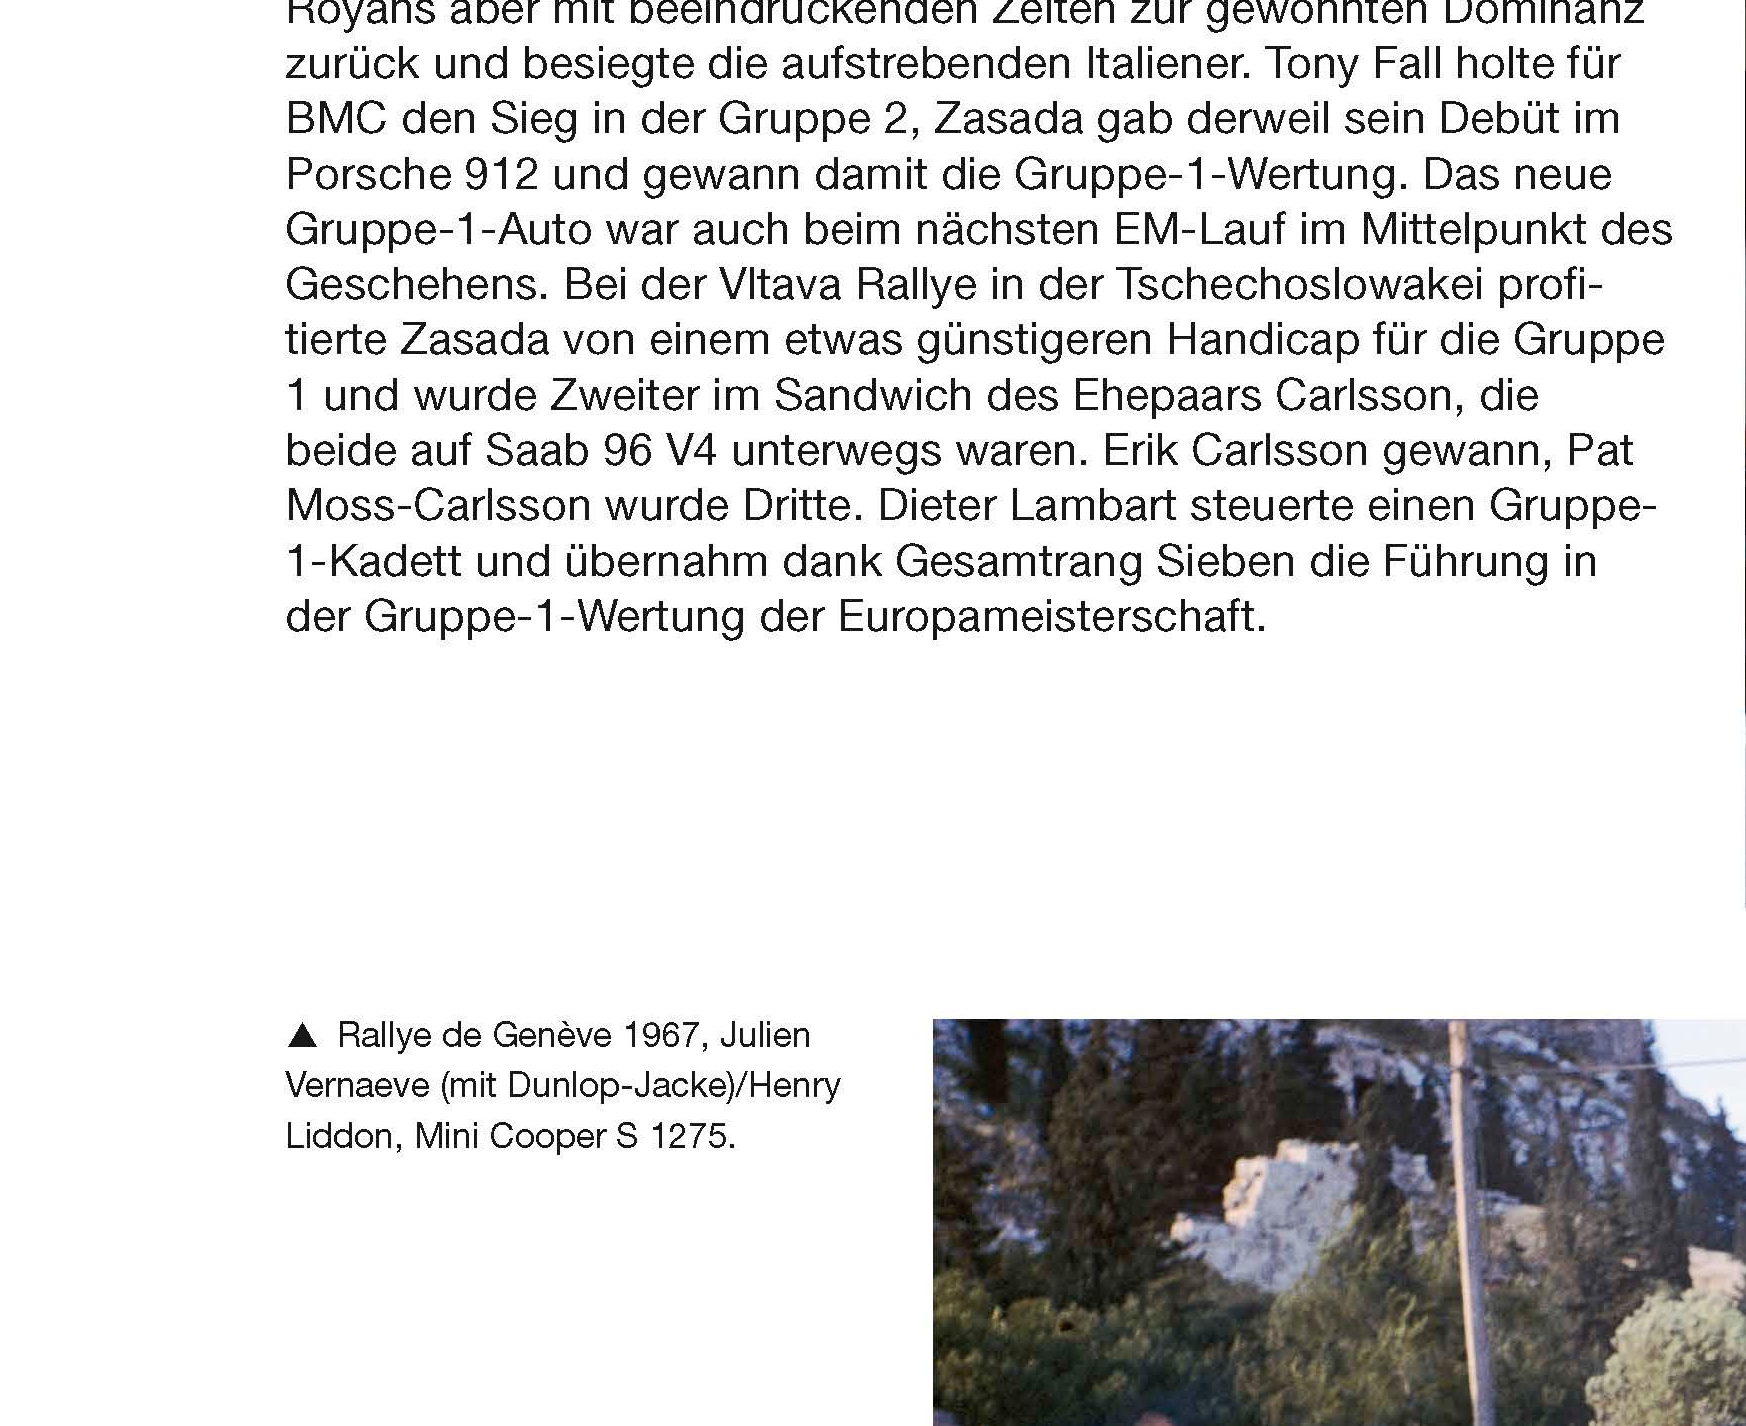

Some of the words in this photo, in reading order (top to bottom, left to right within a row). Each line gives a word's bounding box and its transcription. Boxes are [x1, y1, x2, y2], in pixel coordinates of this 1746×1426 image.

[286, 598, 352, 633] der
[365, 597, 744, 642] Gruppe-1-Wertung
[760, 598, 826, 633] der
[840, 597, 1265, 641] Europameisterschaft.
[339, 1020, 432, 1055] Rallye
[442, 1020, 482, 1048] de
[493, 1020, 612, 1048] Genève
[625, 1020, 708, 1053] 1967,
[720, 1020, 810, 1048] Julien
[284, 1070, 430, 1098] Vernaeve
[441, 1070, 497, 1105] (mit
[509, 1070, 842, 1105] Dunlop-Jacke)/Henry
[287, 1121, 402, 1154] Liddon,
[416, 1121, 478, 1149] Mini
[490, 1121, 608, 1156] Cooper
[616, 1121, 638, 1149] S
[652, 1121, 735, 1149] 1275.
